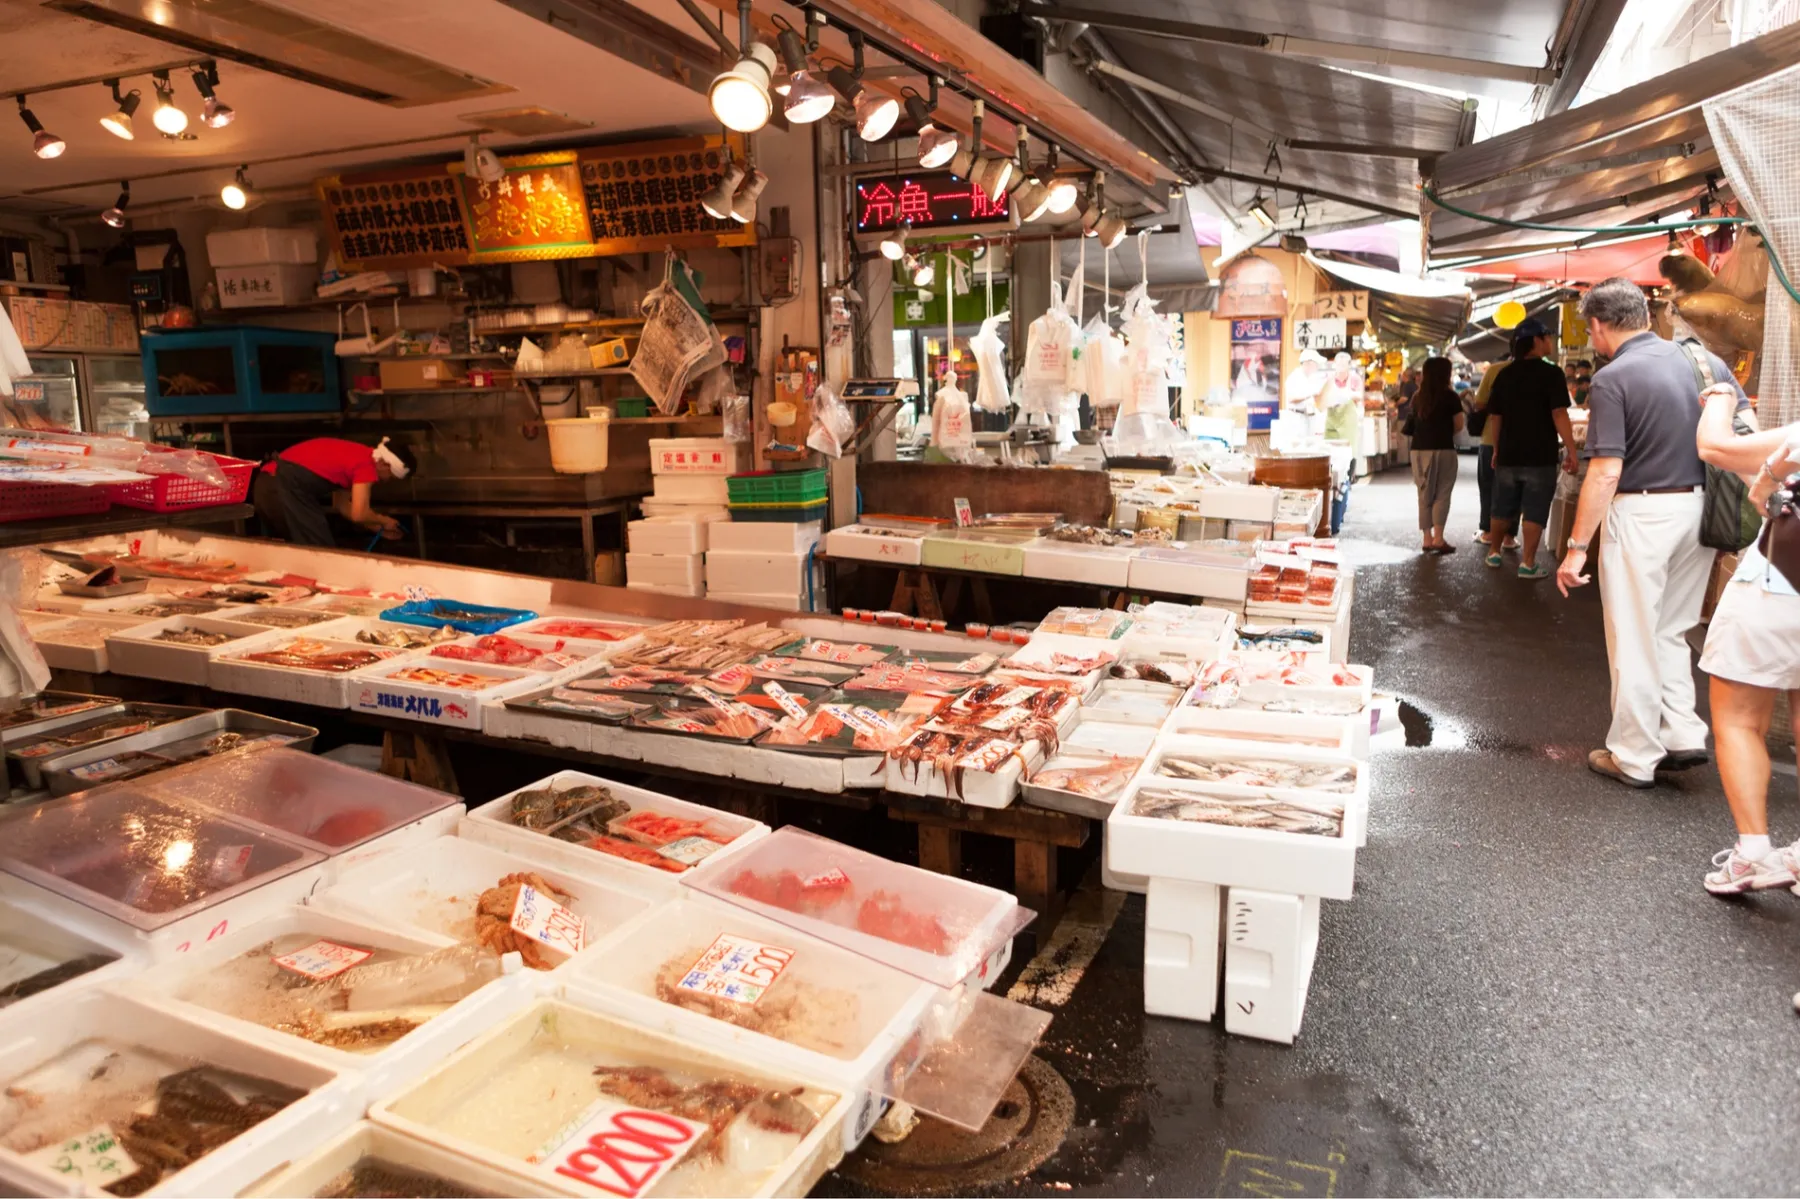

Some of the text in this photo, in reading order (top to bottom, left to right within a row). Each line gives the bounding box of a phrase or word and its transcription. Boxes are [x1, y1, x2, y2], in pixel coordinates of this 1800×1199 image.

[1315, 293, 1364, 311] つきじ
[554, 1110, 694, 1199] 1200
